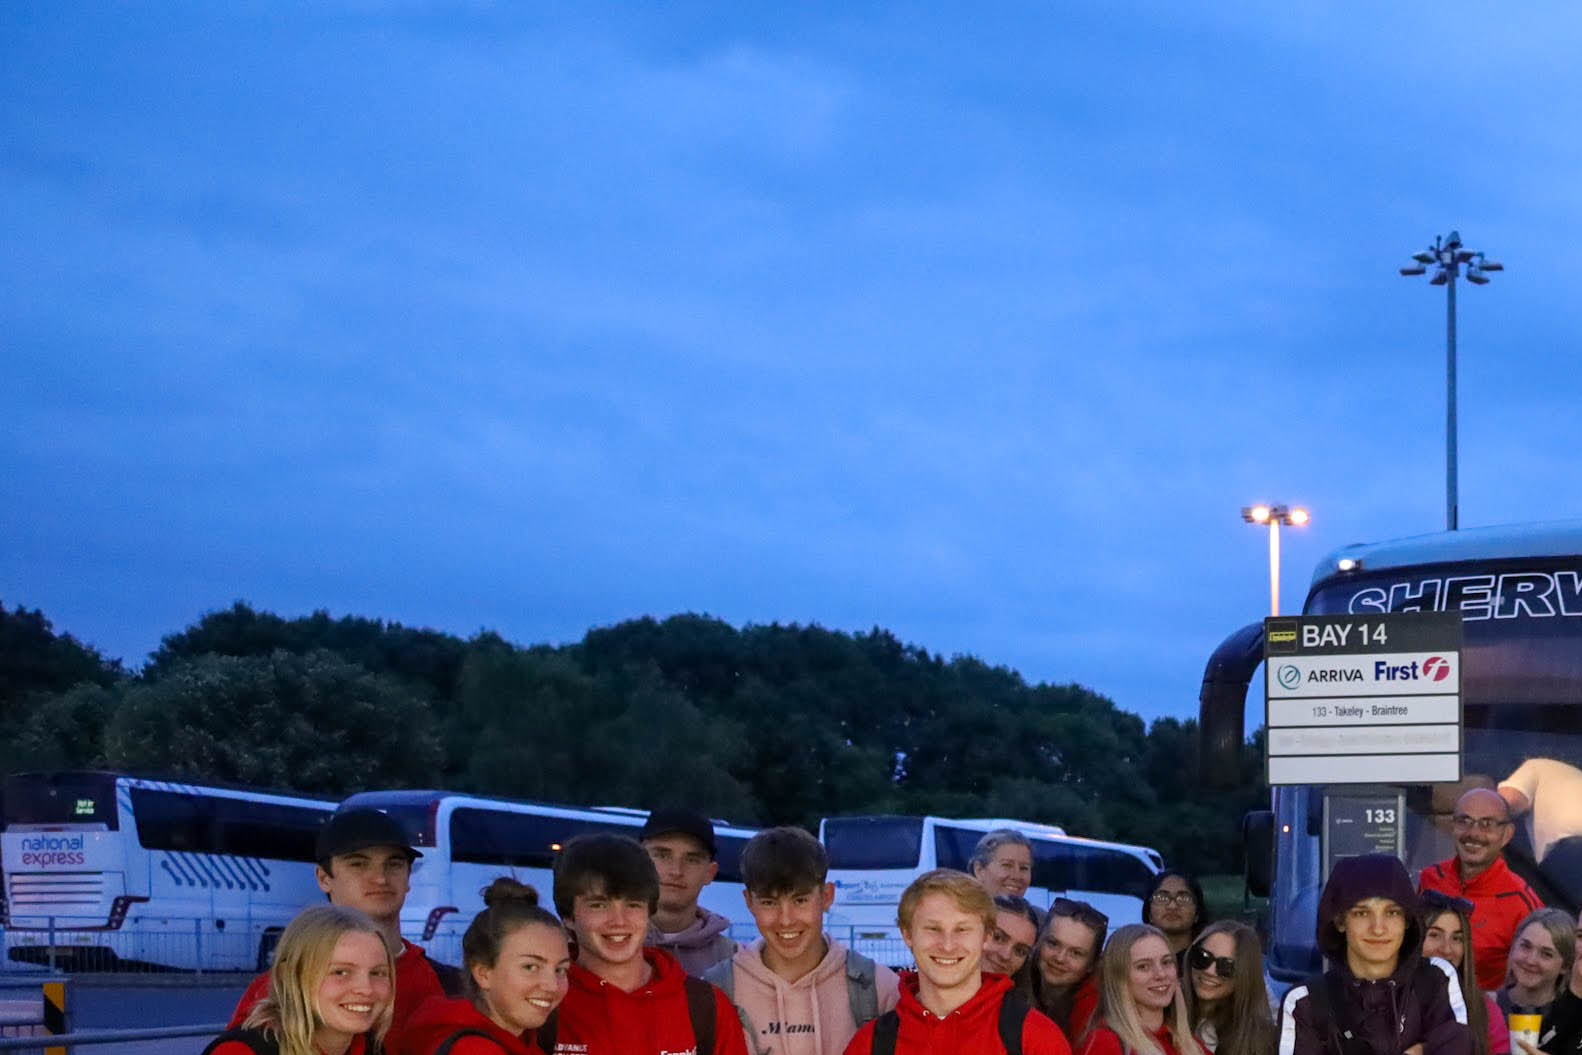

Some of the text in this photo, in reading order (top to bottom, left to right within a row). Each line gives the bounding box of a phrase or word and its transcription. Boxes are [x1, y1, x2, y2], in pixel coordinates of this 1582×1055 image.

[1302, 623, 1388, 647] BAY 14
[1307, 669, 1364, 683] ARRIVA
[1374, 660, 1419, 681] First
[1312, 706, 1327, 718] 133
[1334, 706, 1364, 719] Takeley
[1371, 705, 1408, 717] Braintree
[1365, 809, 1396, 824] 133
[22, 833, 84, 851] national
[22, 851, 85, 869] express
